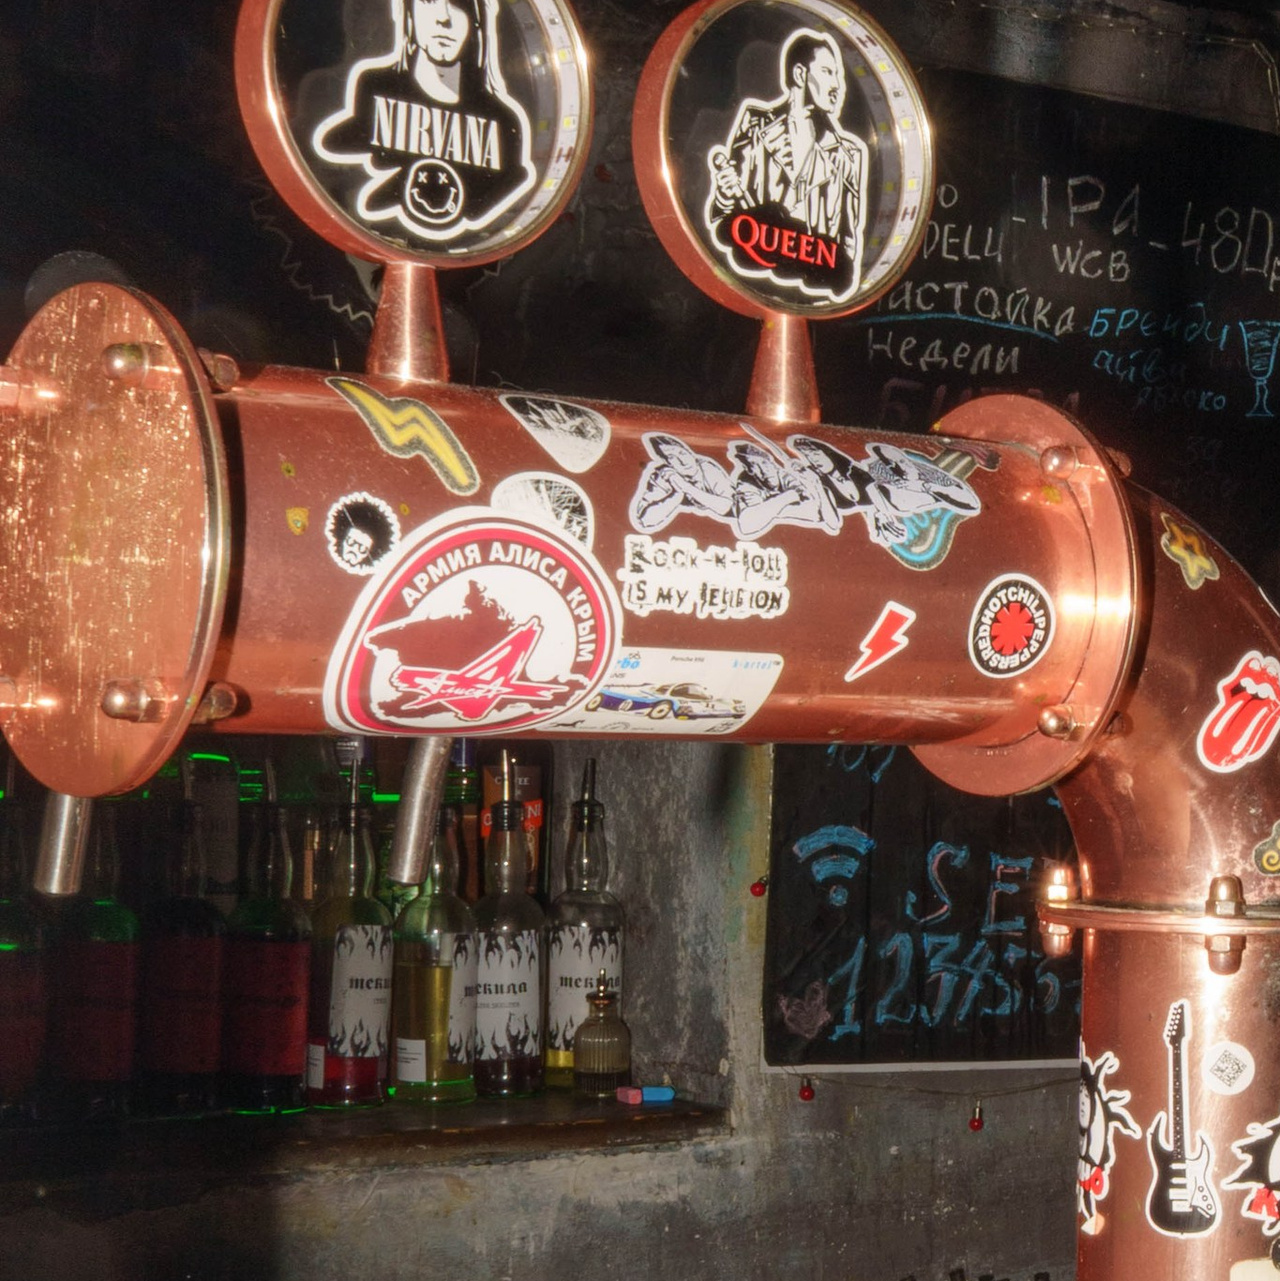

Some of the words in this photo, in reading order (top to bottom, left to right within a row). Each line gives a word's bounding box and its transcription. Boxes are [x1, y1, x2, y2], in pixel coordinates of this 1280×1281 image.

[369, 95, 502, 171] NIRVANA
[731, 213, 838, 270] QUEEN
[877, 281, 1076, 337] АСТОЙКА
[401, 543, 482, 608] АРМИЯ
[489, 541, 568, 591] АЛИСА
[565, 586, 598, 664] КРЫМ
[628, 580, 647, 606] IS
[656, 587, 688, 608] MY
[699, 582, 783, 614] RELIGION
